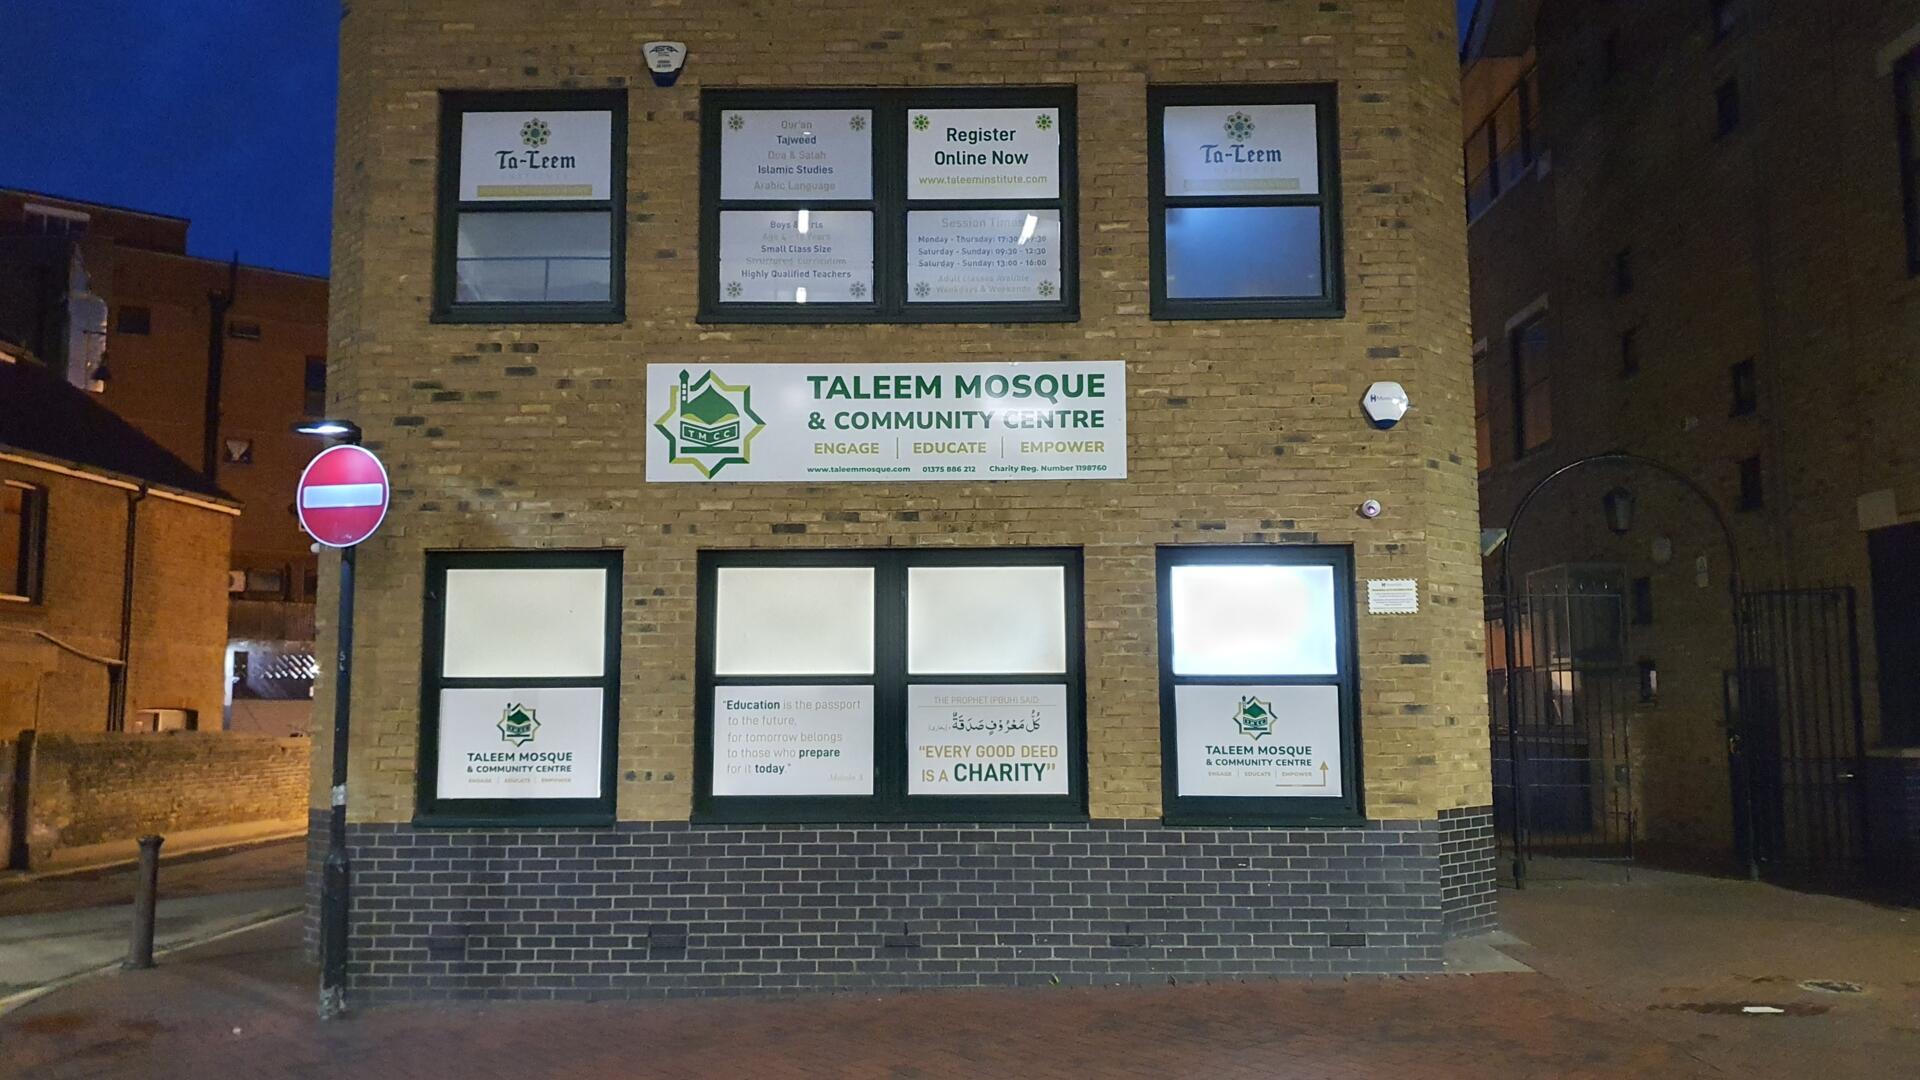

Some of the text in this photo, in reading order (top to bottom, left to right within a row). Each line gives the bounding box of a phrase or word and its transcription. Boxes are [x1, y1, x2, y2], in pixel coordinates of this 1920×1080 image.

[777, 135, 816, 145] Tajweed
[946, 128, 1016, 144] Register
[935, 151, 1029, 166] Online Now
[1199, 144, 1281, 163] Ta-Leem
[494, 150, 575, 169] Ta-Leem
[758, 165, 833, 174] Islamic Studies
[919, 174, 1047, 185] www.taleeminstitute.com
[770, 221, 791, 230] Boys
[918, 236, 948, 244] Monday
[761, 245, 832, 253] Small Class Size
[918, 248, 953, 256] Saturday
[918, 260, 954, 268] Saturday
[741, 270, 852, 280] Highly Qualified Teachers
[807, 373, 1106, 403] TALEEM MOSQUE
[808, 409, 1105, 430] & COMMUNITY CENTRE
[814, 442, 879, 455] ENGAGE
[913, 442, 987, 454] EDUCATE
[1020, 440, 1105, 454] EMPOWER
[807, 465, 911, 474] www.taleemmosque.com
[922, 465, 944, 473] 01375
[989, 464, 1020, 474] Charity
[1021, 464, 1038, 474] Reg.
[1041, 464, 1074, 472] Number
[1075, 463, 1107, 472] 1198760
[783, 700, 792, 710] is
[796, 700, 812, 709] the
[815, 699, 861, 711] passport
[951, 696, 987, 704] PROPHET
[728, 715, 797, 726] to the future,
[728, 732, 843, 743] for tomorrow belongs
[727, 748, 840, 759] to those who prepare
[975, 745, 1015, 758] GOOD
[1021, 745, 1058, 758] DEED
[1205, 746, 1312, 757] TALEEM MOSQUE
[467, 752, 573, 764] TALEEM MOSQUE
[536, 765, 572, 773] CENTRE
[726, 764, 742, 774] for
[744, 764, 751, 774] it
[921, 769, 934, 782] IS
[938, 769, 949, 782] A
